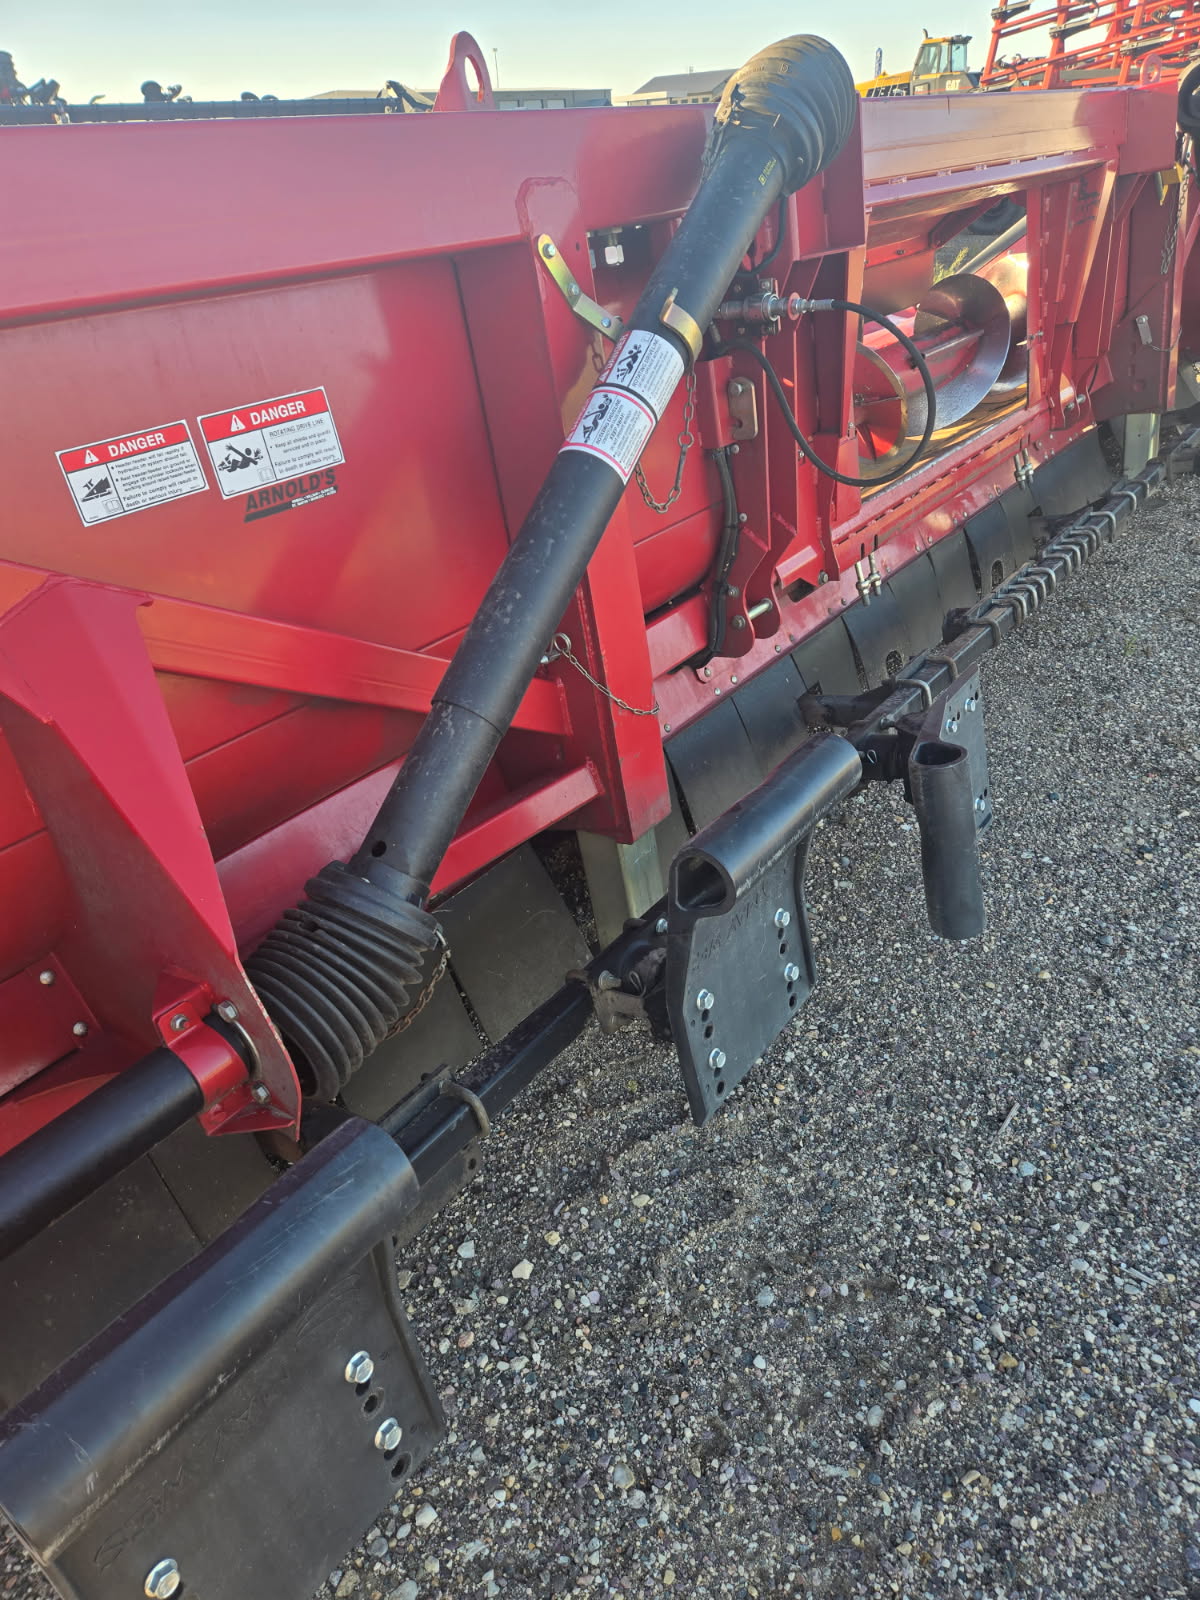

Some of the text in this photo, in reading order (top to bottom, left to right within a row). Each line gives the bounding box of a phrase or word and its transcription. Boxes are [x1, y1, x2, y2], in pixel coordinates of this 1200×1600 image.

[945, 79, 961, 91] CAT
[249, 399, 306, 425] DANGER
[268, 425, 295, 437] ROTATING
[295, 421, 311, 430] DRIVE
[107, 432, 166, 457] DANGER
[122, 492, 141, 501] Failure
[148, 484, 167, 494] comply
[177, 477, 192, 485] result
[125, 499, 140, 507] death
[148, 491, 166, 500] serious
[246, 469, 336, 512] ARNOLD'S
